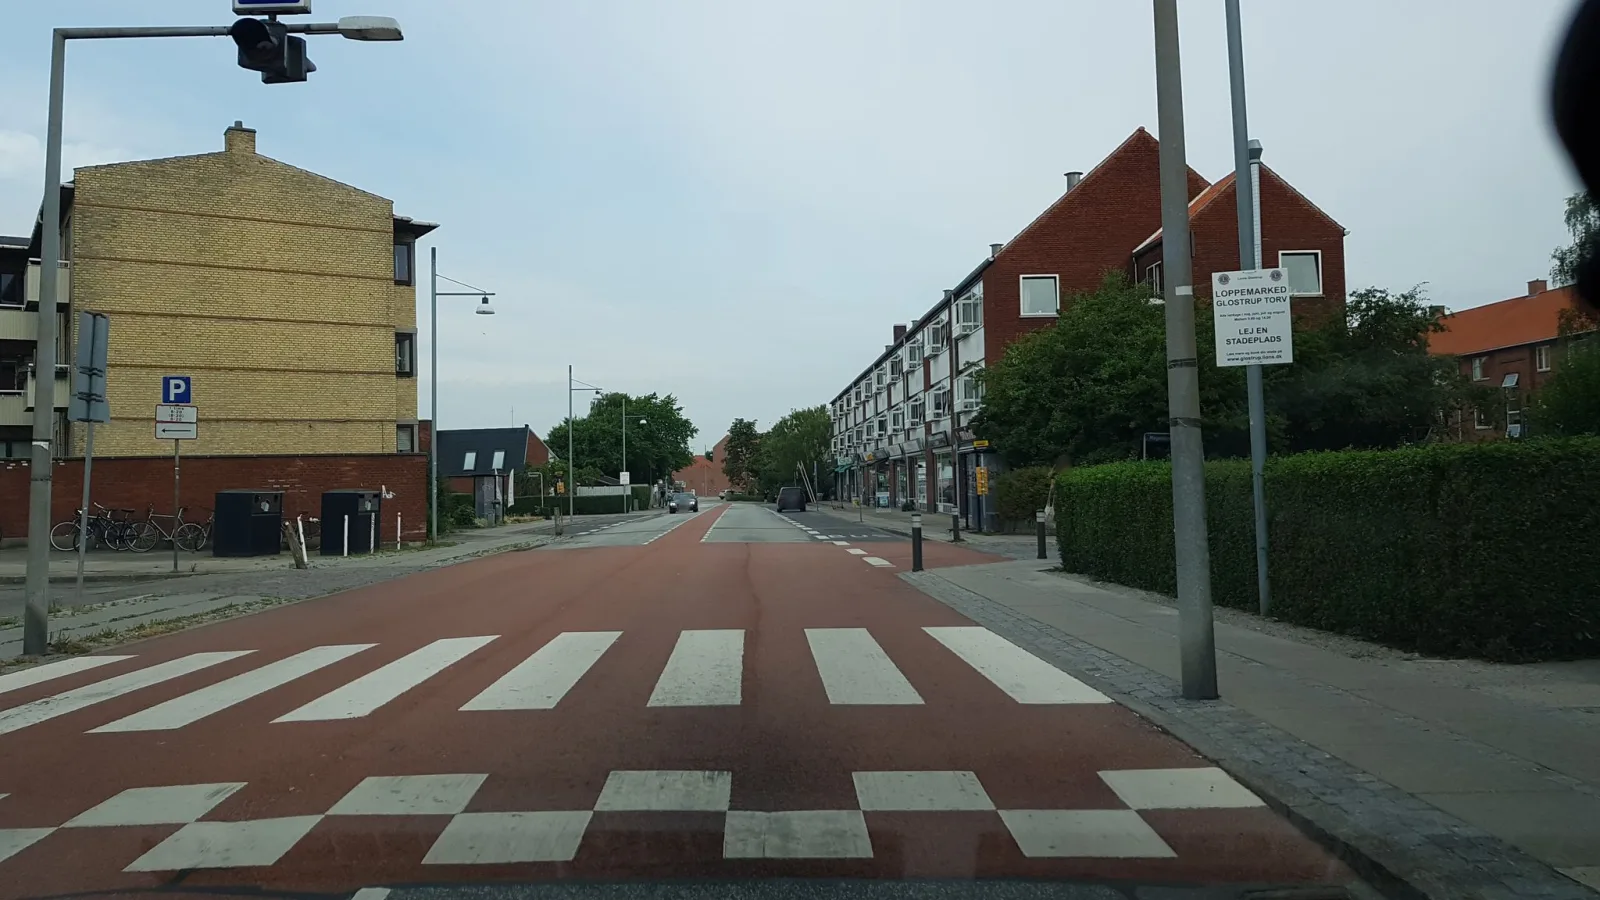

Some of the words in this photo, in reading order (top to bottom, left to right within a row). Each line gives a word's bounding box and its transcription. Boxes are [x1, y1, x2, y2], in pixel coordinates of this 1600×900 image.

[1215, 286, 1287, 297] LOPPEMARKED
[1216, 298, 1262, 307] GLOSTRUP
[1226, 336, 1282, 345] STADEPLADS
[170, 379, 186, 401] P
